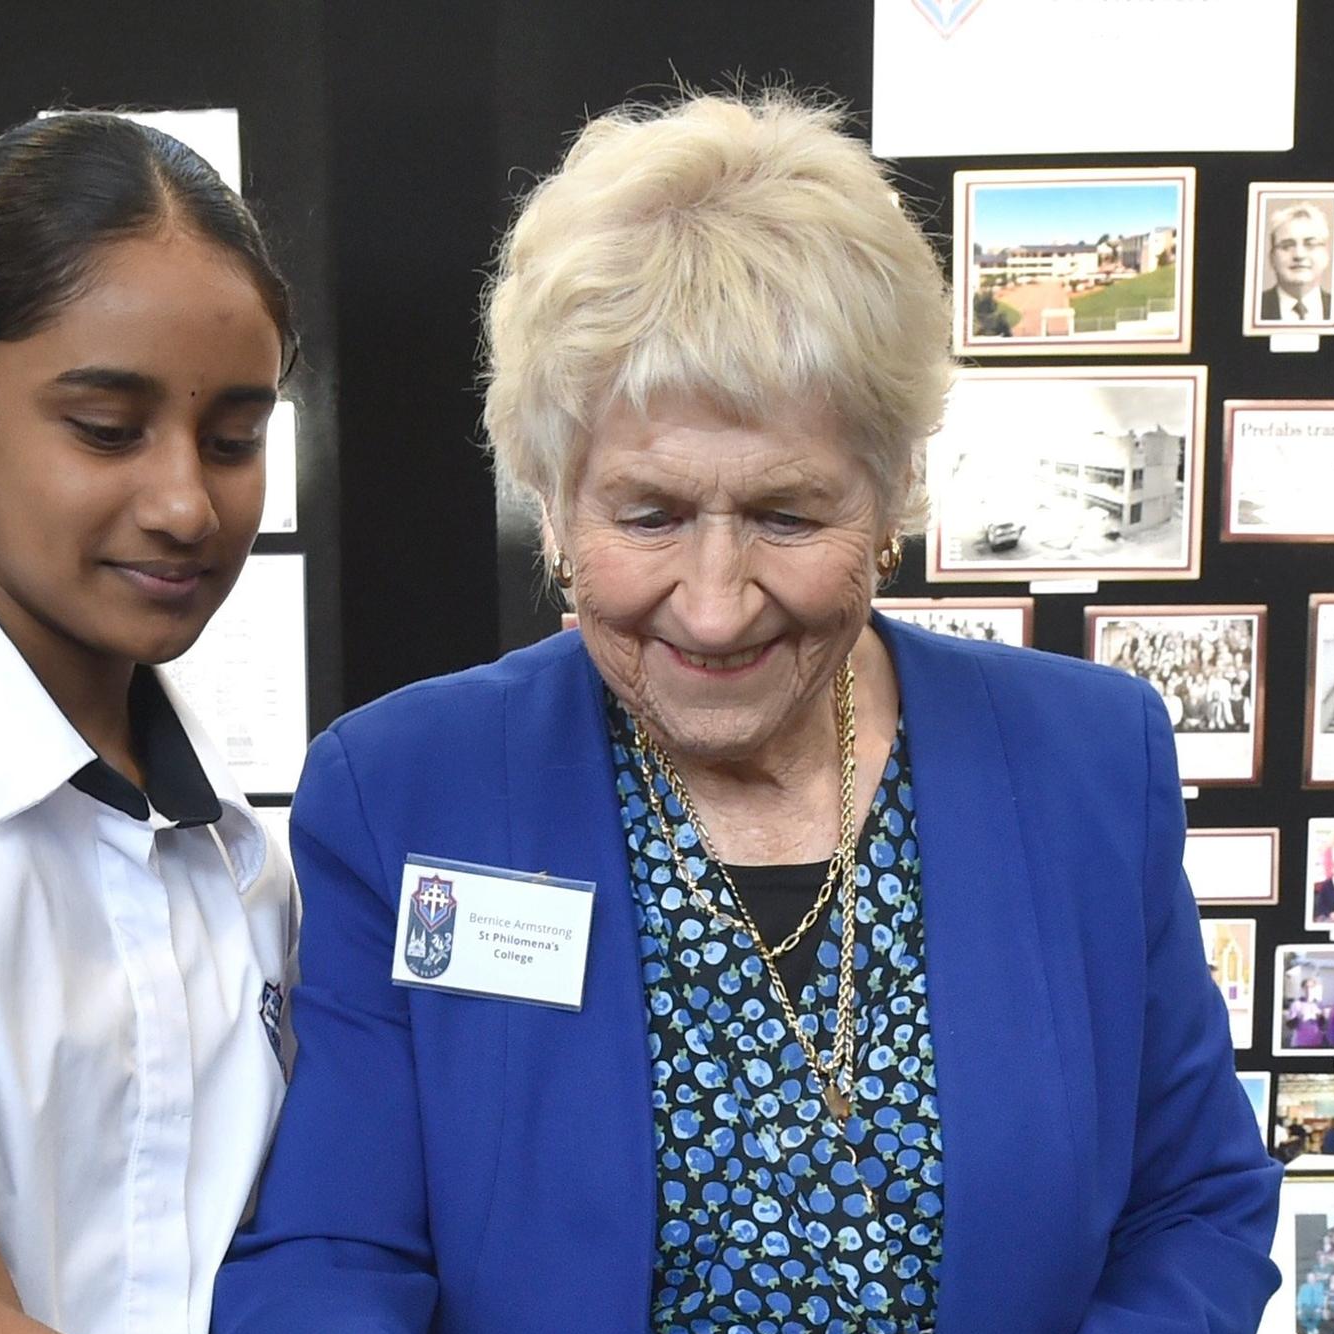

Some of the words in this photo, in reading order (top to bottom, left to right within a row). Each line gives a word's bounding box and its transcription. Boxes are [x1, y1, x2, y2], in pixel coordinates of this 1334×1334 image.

[1241, 422, 1302, 437] Prefabs
[469, 912, 511, 929] Bernice
[513, 919, 573, 939] Armstrong
[478, 930, 490, 941] St
[492, 933, 560, 952] Philomena's
[493, 949, 534, 964] College
